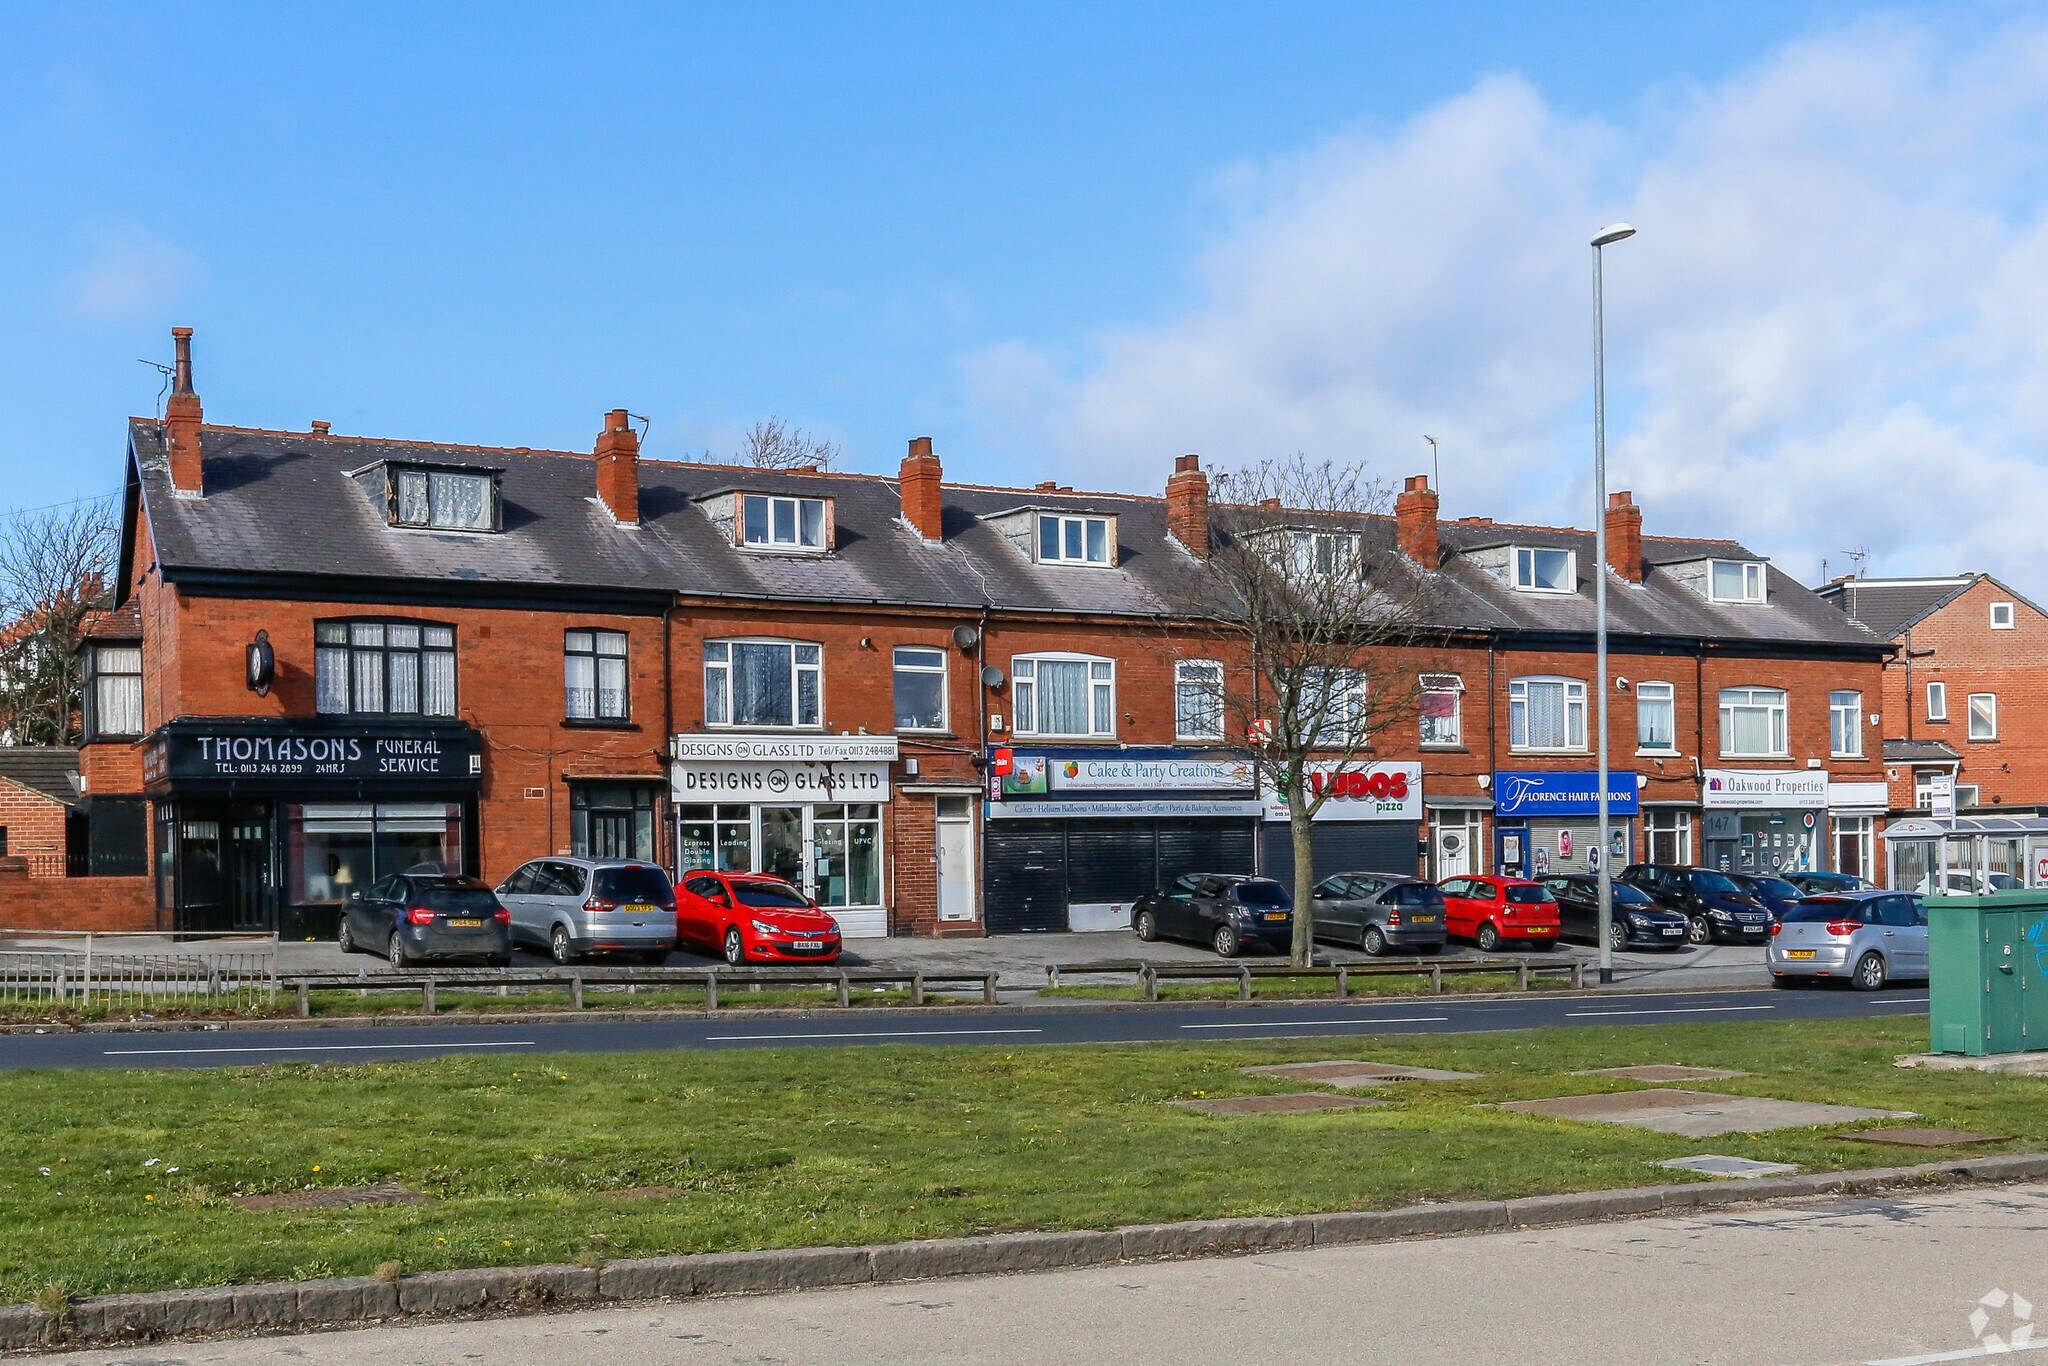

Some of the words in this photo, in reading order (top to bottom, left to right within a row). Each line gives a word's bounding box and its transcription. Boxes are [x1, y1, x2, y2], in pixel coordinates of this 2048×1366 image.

[197, 736, 362, 761] THOMASONS
[375, 740, 441, 754] FUNERAL
[681, 744, 733, 756] DESIGNS
[753, 744, 790, 757] GLASS
[792, 744, 814, 757] LTD
[818, 746, 848, 756] Tel/Fax
[848, 747, 864, 756] 0113
[215, 763, 238, 773] TEL:
[240, 764, 258, 773] 0113
[260, 764, 277, 773] 248
[280, 764, 303, 773] 2899
[315, 764, 346, 773] 24HRS
[379, 758, 440, 772] SERVICE
[1087, 763, 1118, 778] Cake
[1121, 762, 1133, 778] &
[1135, 762, 1166, 783] Party
[1168, 762, 1224, 779] Creations
[686, 772, 762, 790] DESIGNS
[771, 776, 787, 786] ON
[795, 772, 846, 789] GLASS
[851, 772, 879, 790] LTD
[1311, 771, 1409, 799] LUDOS
[1728, 777, 1771, 792] Oakwood
[1775, 778, 1824, 795] Properties
[1568, 792, 1589, 801] HAIR
[1014, 805, 1034, 813] Cakes
[1038, 804, 1061, 813] Helium
[1062, 804, 1088, 813] Balloons
[1091, 804, 1122, 813] Milkshake
[1146, 804, 1165, 814] Coffee
[1169, 804, 1185, 813] Party
[1376, 801, 1403, 814] pizza
[1708, 816, 1729, 831] 147
[684, 839, 710, 848] Express
[684, 847, 710, 855] Double
[683, 856, 711, 865] Glazing
